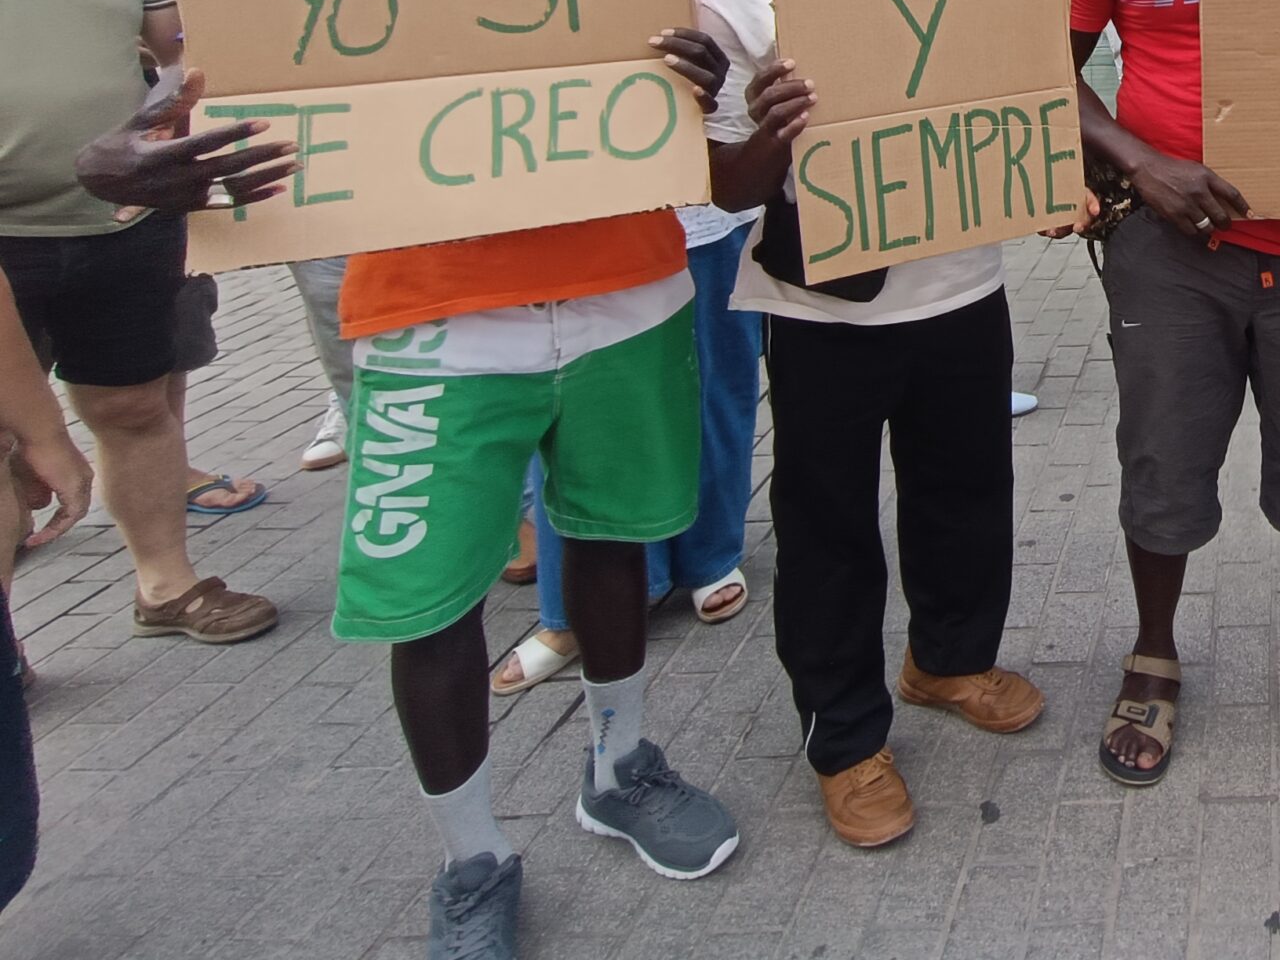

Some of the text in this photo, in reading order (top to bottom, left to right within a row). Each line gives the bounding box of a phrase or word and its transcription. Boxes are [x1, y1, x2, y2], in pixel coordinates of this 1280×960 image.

[203, 71, 678, 223] TE CREO
[799, 98, 1078, 264] SIEMPRE
